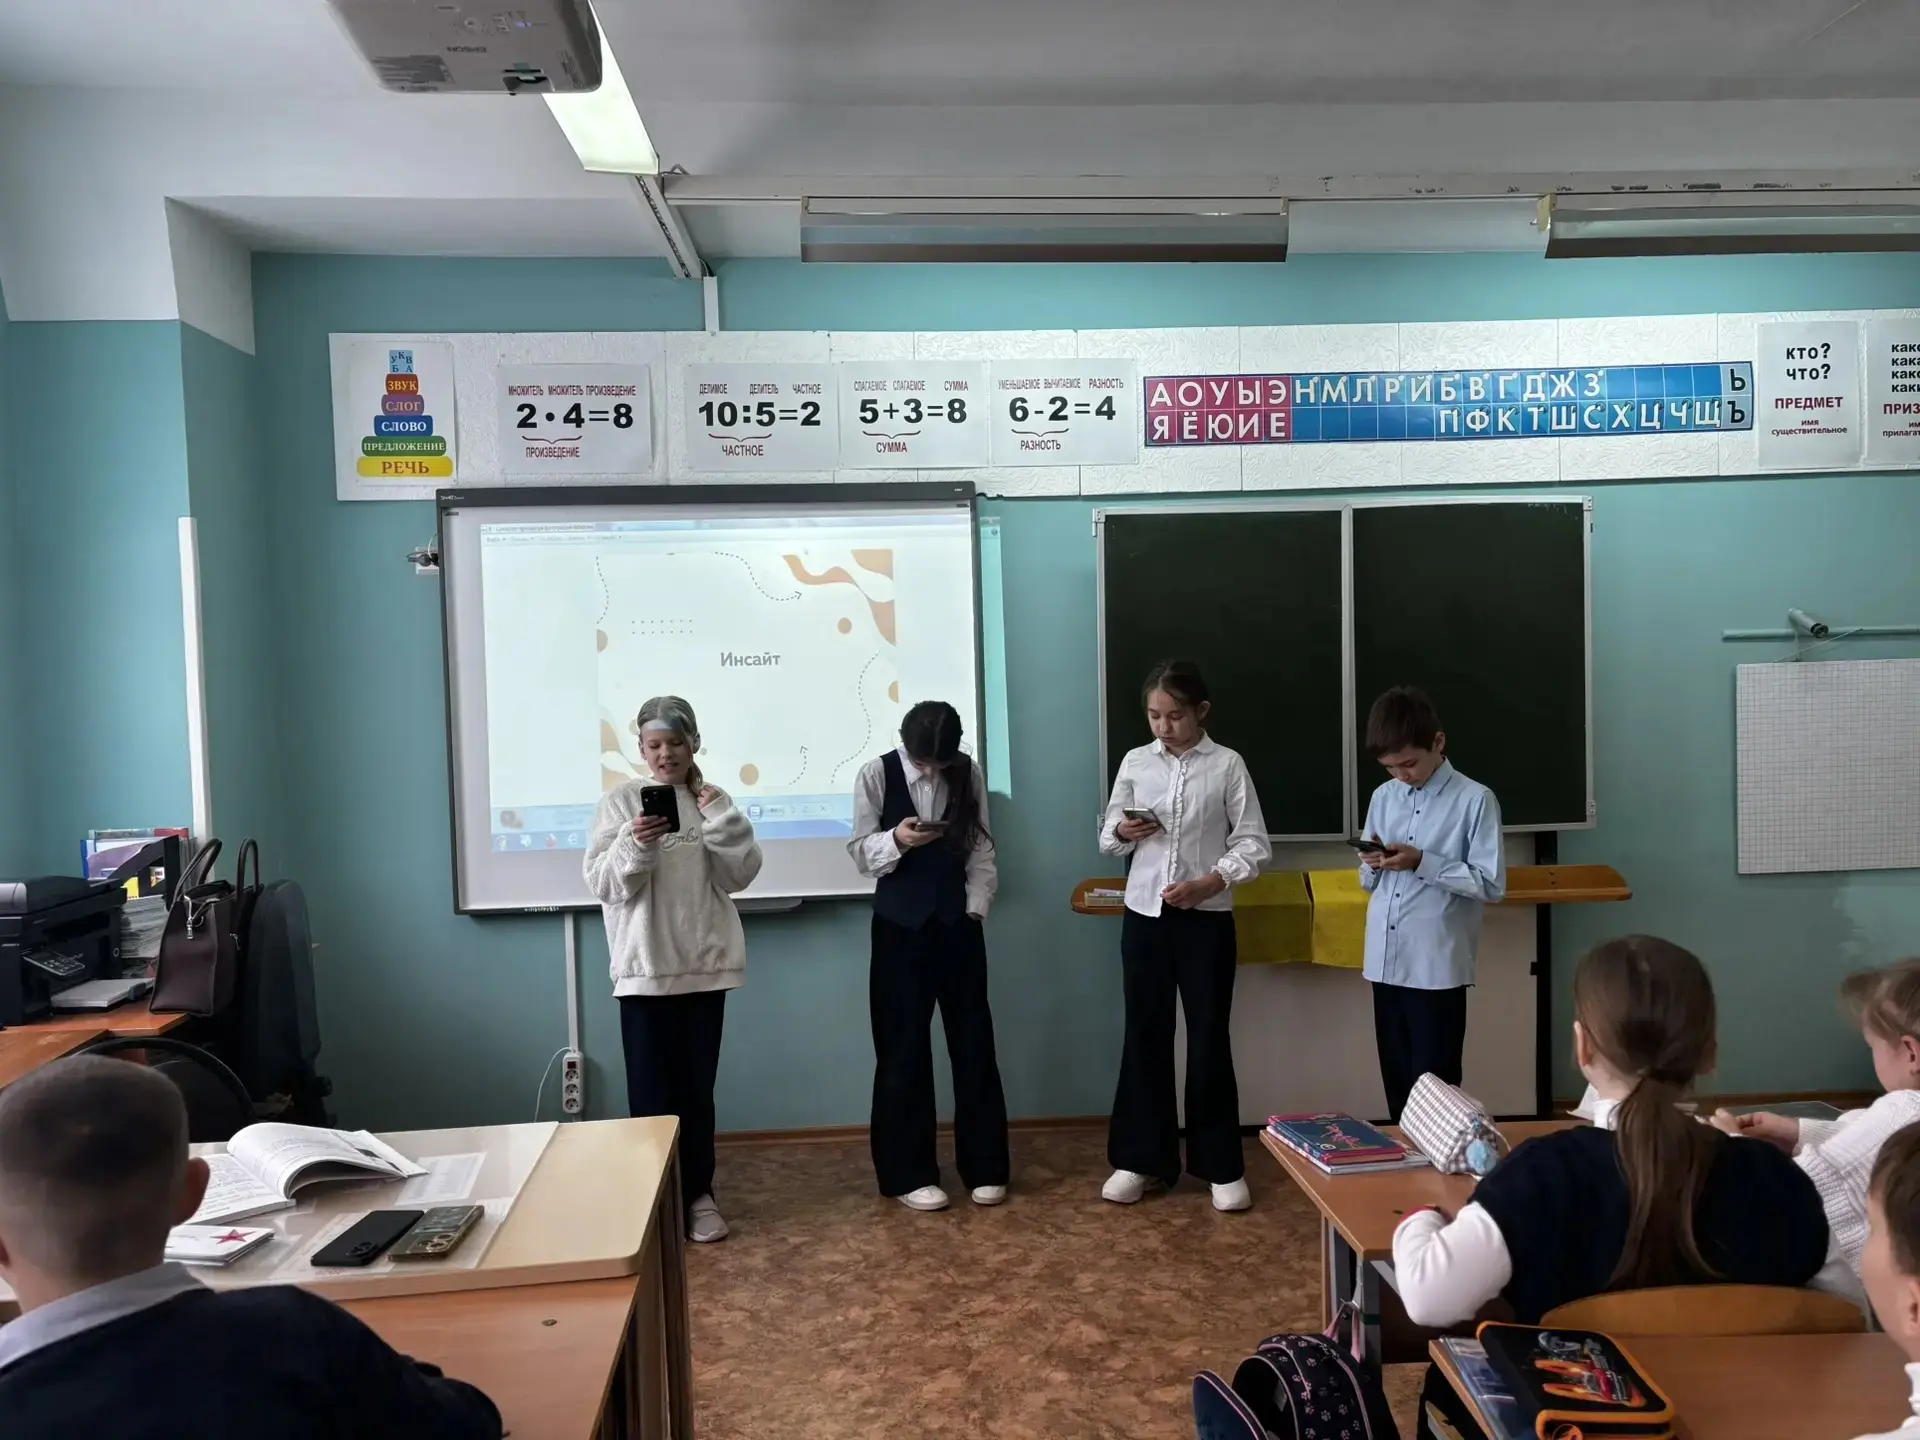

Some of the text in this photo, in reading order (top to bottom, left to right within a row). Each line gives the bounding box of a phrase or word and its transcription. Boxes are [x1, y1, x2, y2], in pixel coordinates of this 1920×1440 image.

[1786, 343, 1831, 359] кто?
[1786, 364, 1831, 380] что?
[387, 380, 417, 391] ЗВУК
[854, 380, 969, 392] СЛАГАЕМОЕ СЛАГАЕМОЕ СУММА
[998, 378, 1124, 389] УМЕНЬШАЕМОЕ ВЫЧИТАЕМОЕ РАЗНОСТЬ
[508, 385, 637, 398] МНОЖИТЕЛЬ МНОЖИТЕЛЬ ПРОИЗВЕДЕНИЕ
[699, 383, 822, 396] ДЕЛИМОЕ ДЕЛИТЕЛЬ ЧАСТНОЕ
[385, 401, 421, 412] СЛОГ
[1775, 397, 1843, 410] ПРЕДМЕТ
[381, 421, 427, 432] СЛОВО
[1772, 427, 1847, 437] существительное
[363, 442, 446, 452] ПРЕДЛОЖЕНИЕ
[722, 445, 764, 456] ЧАСТНОЕ
[876, 442, 908, 453] СУММА
[1020, 440, 1062, 451] РАЗНОСТЬ
[525, 447, 580, 459] ПРОИЗВЕДЕНИЕ
[381, 461, 430, 474] РЕЧЬ
[721, 652, 780, 667] Инсайт
